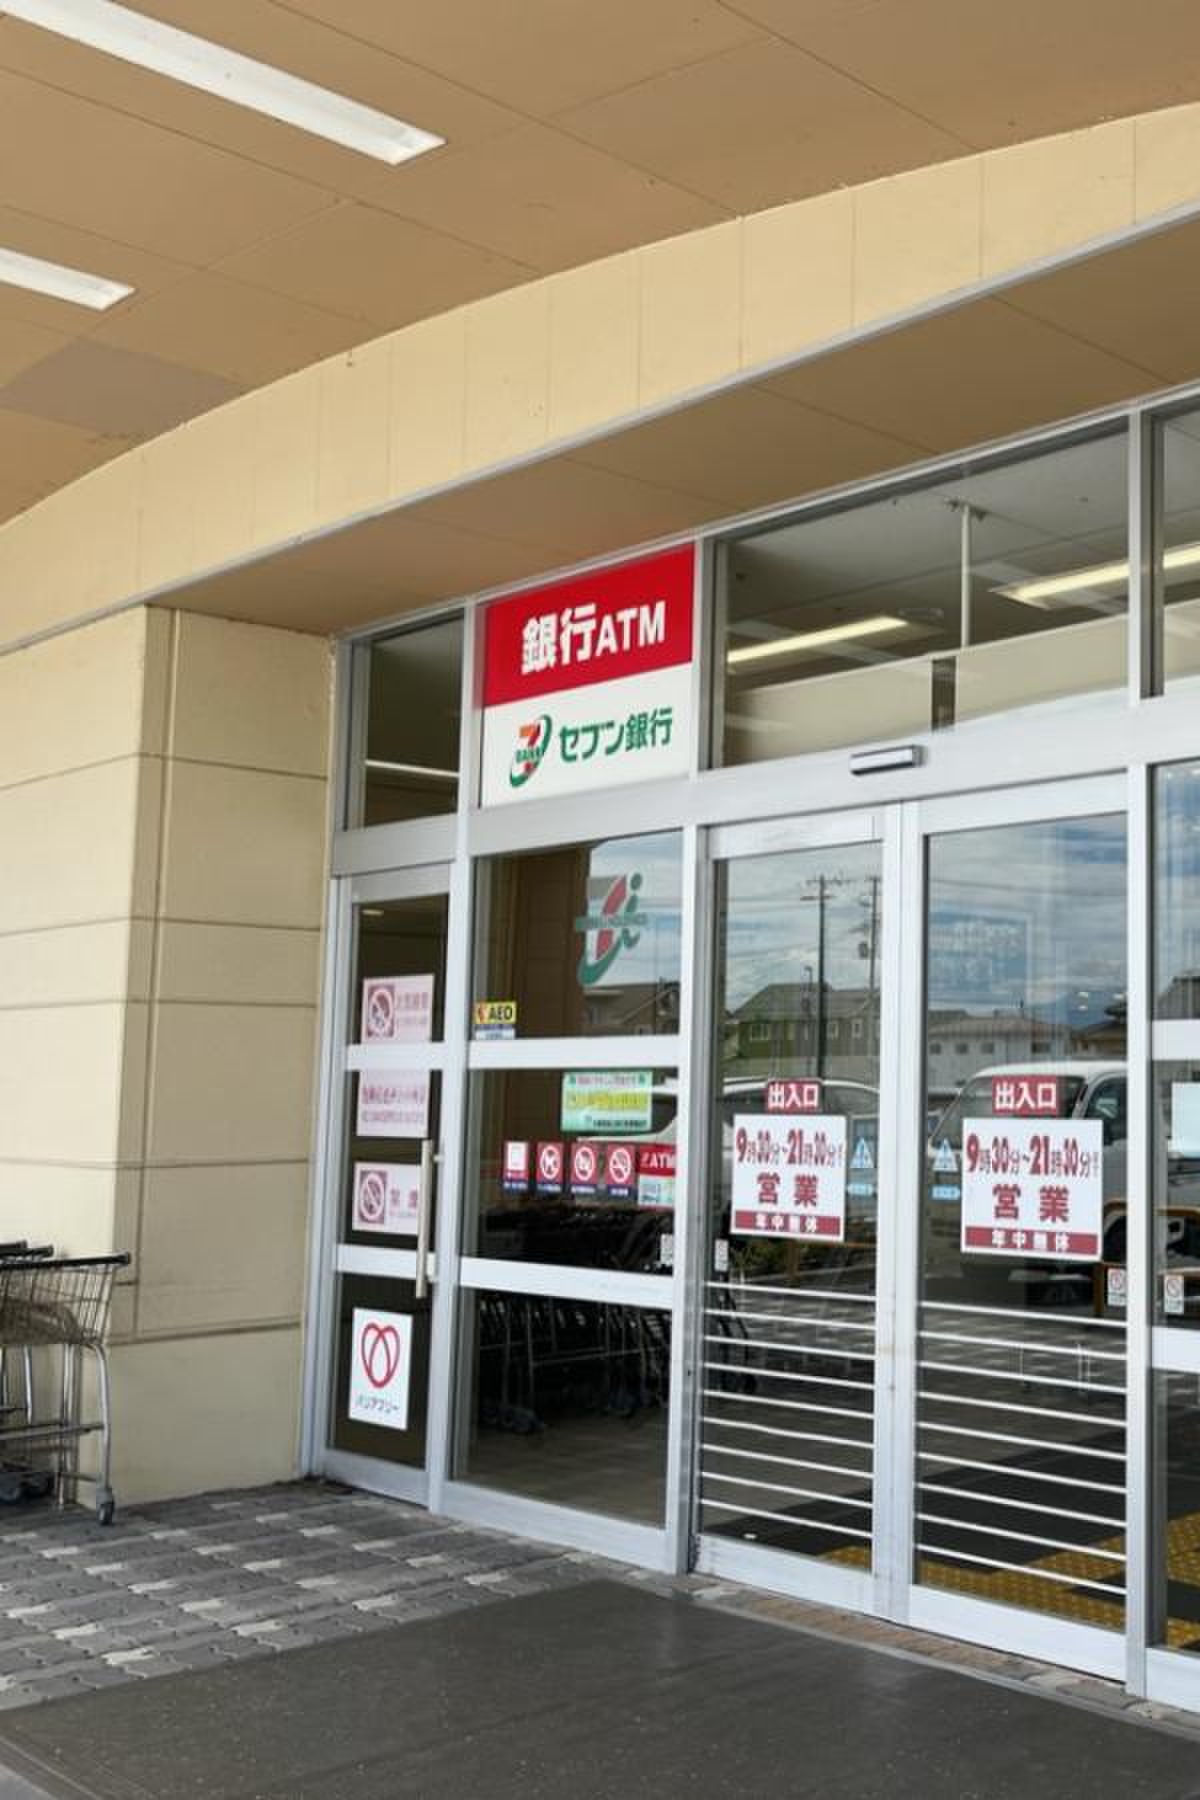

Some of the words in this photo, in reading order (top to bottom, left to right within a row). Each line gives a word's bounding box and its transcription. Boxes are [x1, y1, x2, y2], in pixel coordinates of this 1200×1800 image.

[521, 600, 667, 676] 銀行ATM
[559, 707, 673, 763] セブン銀行
[768, 1082, 819, 1110] 出入口
[995, 1081, 1057, 1111] 出入口
[991, 1184, 1070, 1223] 営業
